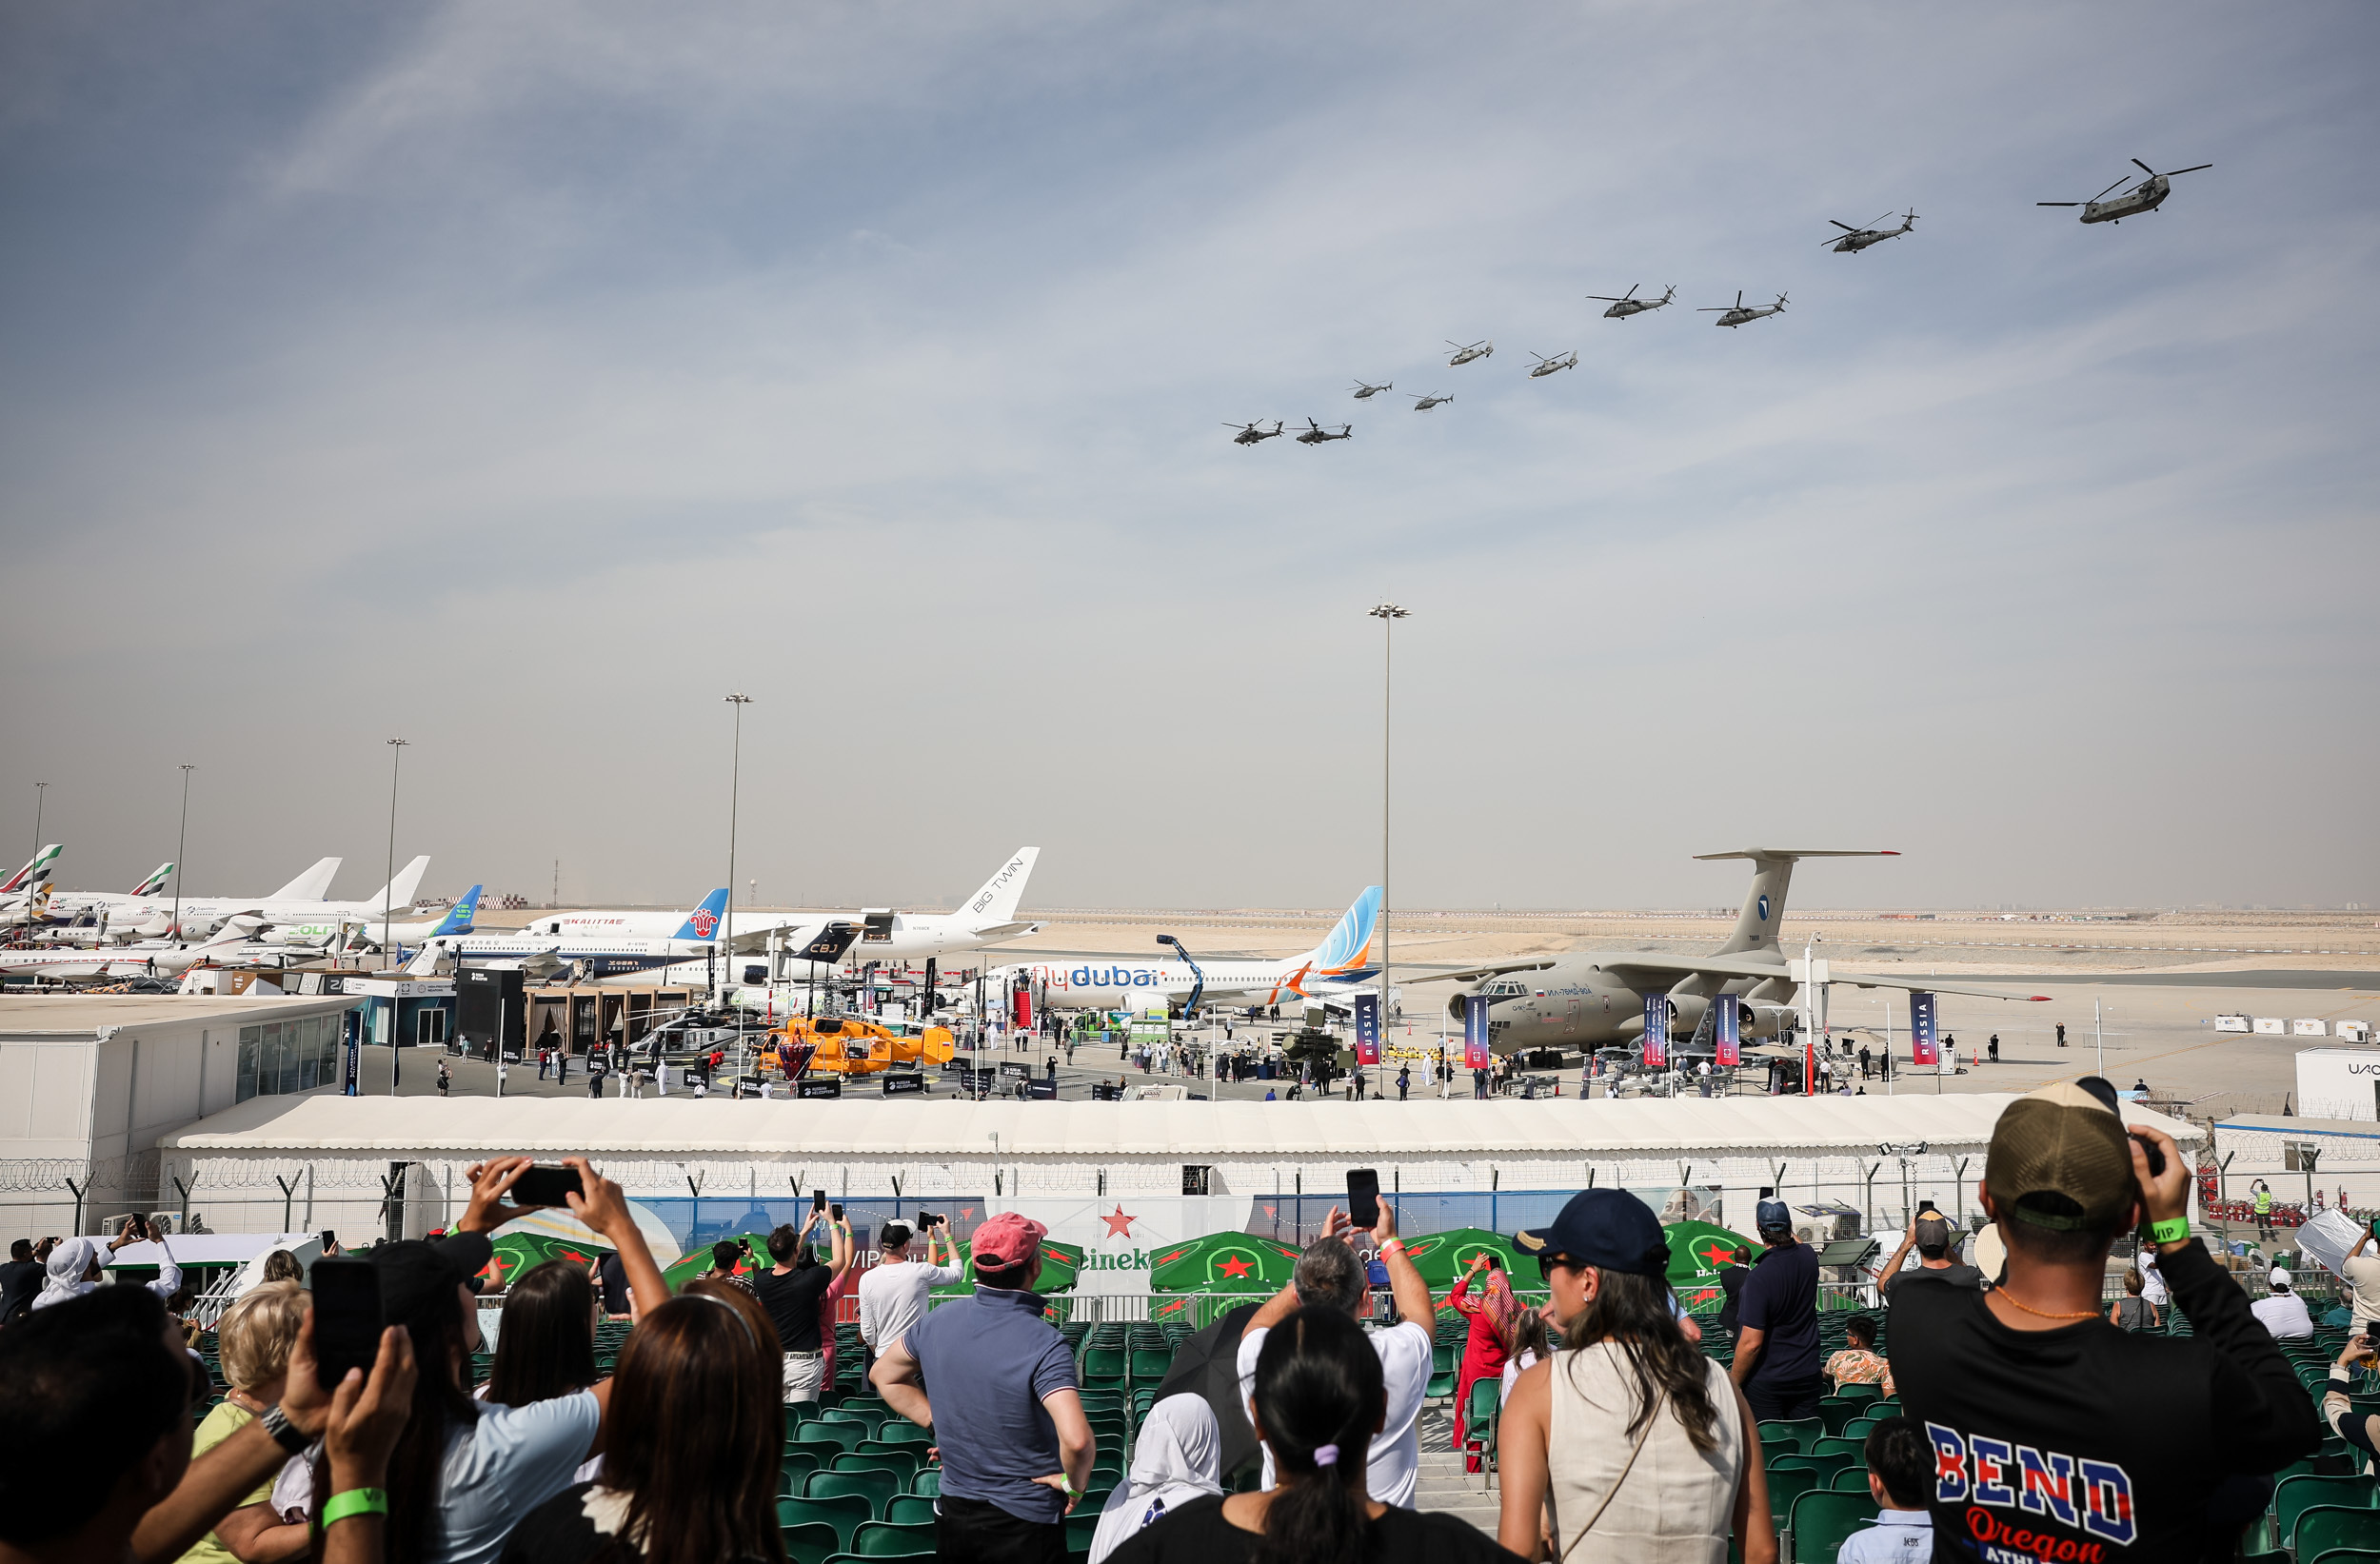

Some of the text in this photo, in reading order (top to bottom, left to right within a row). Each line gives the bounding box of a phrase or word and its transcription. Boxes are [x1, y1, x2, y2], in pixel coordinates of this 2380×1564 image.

[972, 857, 1023, 914] BIG TWIN
[809, 943, 839, 954] CBJ
[1031, 964, 1166, 992] flydubai
[1362, 1004, 1374, 1056] RUSSIA
[1918, 1003, 1930, 1056] RUSSIA
[1081, 1247, 1150, 1271] einek
[2152, 1226, 2174, 1240] VIP
[1923, 1420, 2138, 1547] BEND
[1965, 1505, 2107, 1564] Oregon
